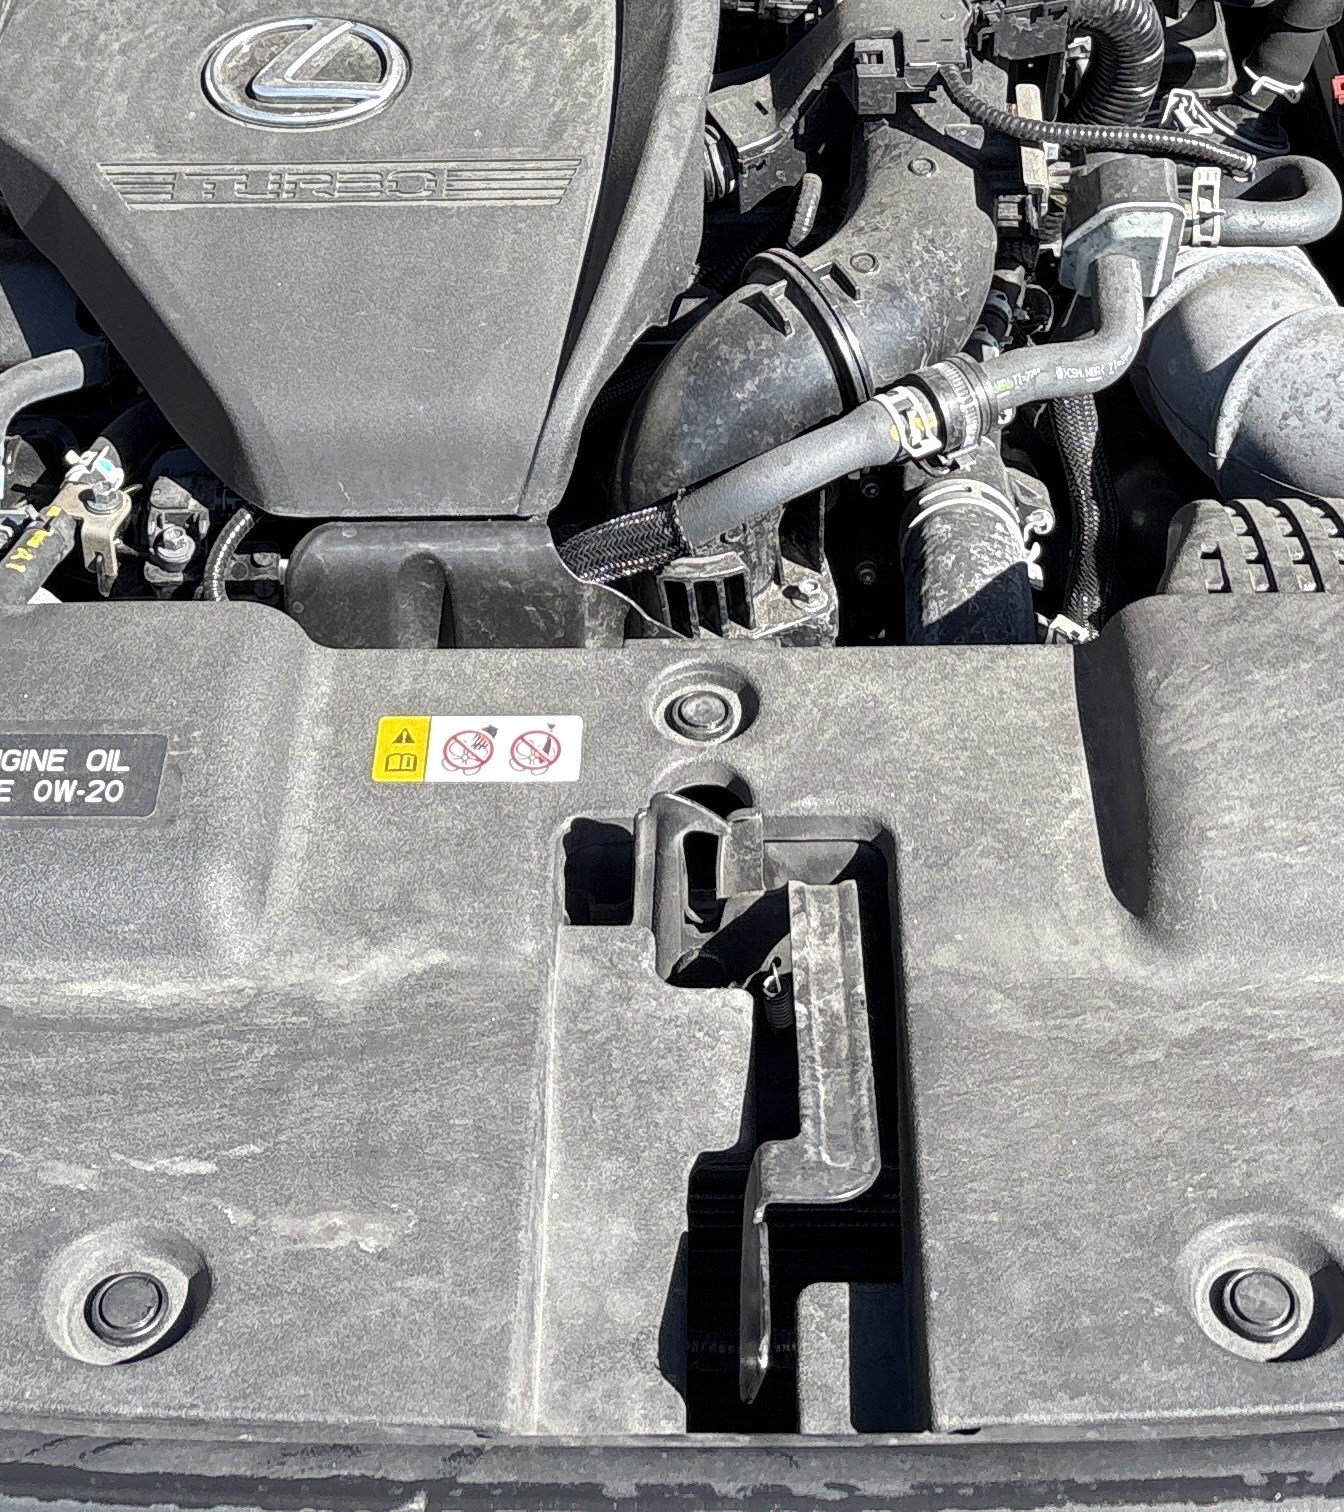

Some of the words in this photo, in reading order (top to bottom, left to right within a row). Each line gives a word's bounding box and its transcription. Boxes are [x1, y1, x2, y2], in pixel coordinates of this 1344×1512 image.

[178, 170, 440, 200] TURBO
[85, 748, 130, 772] OIL
[33, 779, 124, 803] 0W-20
